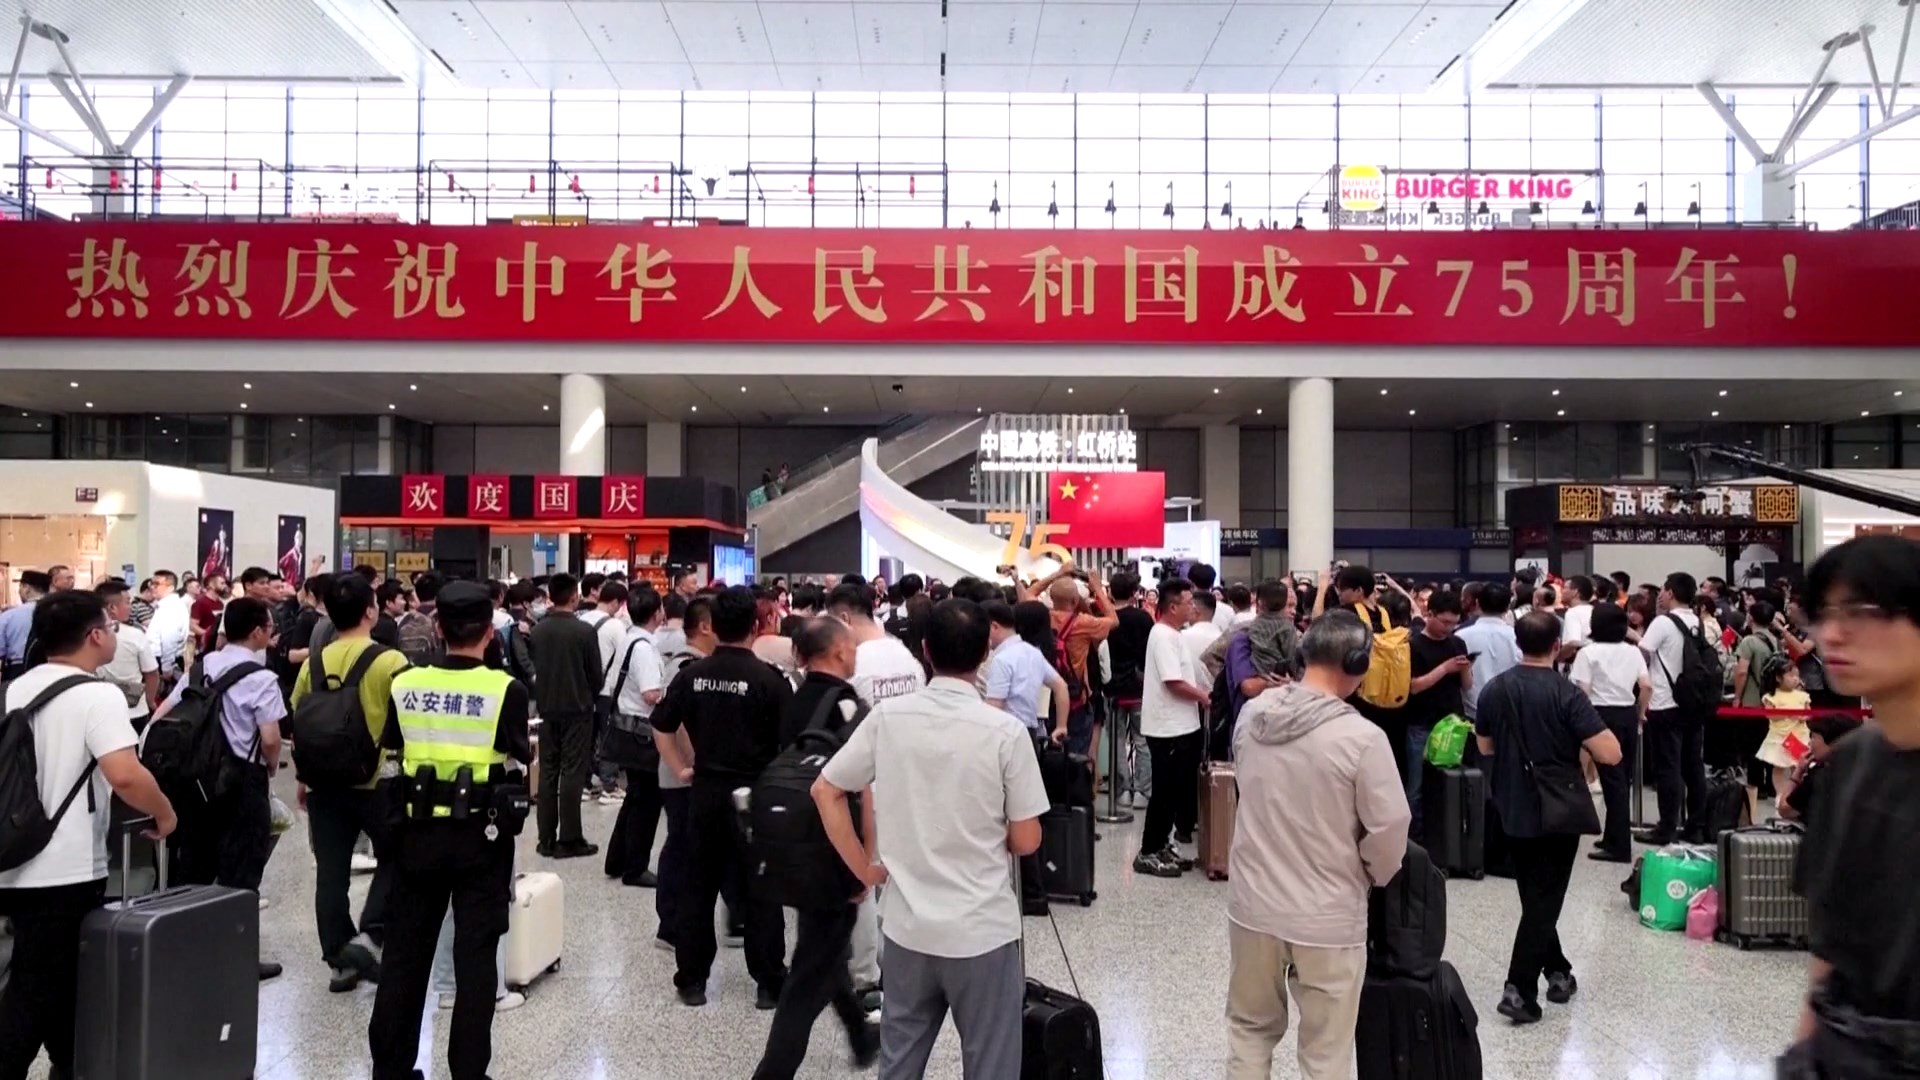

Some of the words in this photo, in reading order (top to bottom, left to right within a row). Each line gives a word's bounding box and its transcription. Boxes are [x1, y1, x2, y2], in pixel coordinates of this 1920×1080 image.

[1341, 188, 1381, 200] KING
[1395, 177, 1500, 199] BURGER
[1508, 177, 1574, 199] KING
[407, 481, 638, 513] 欢度国庆
[402, 690, 485, 717] 公安辅警
